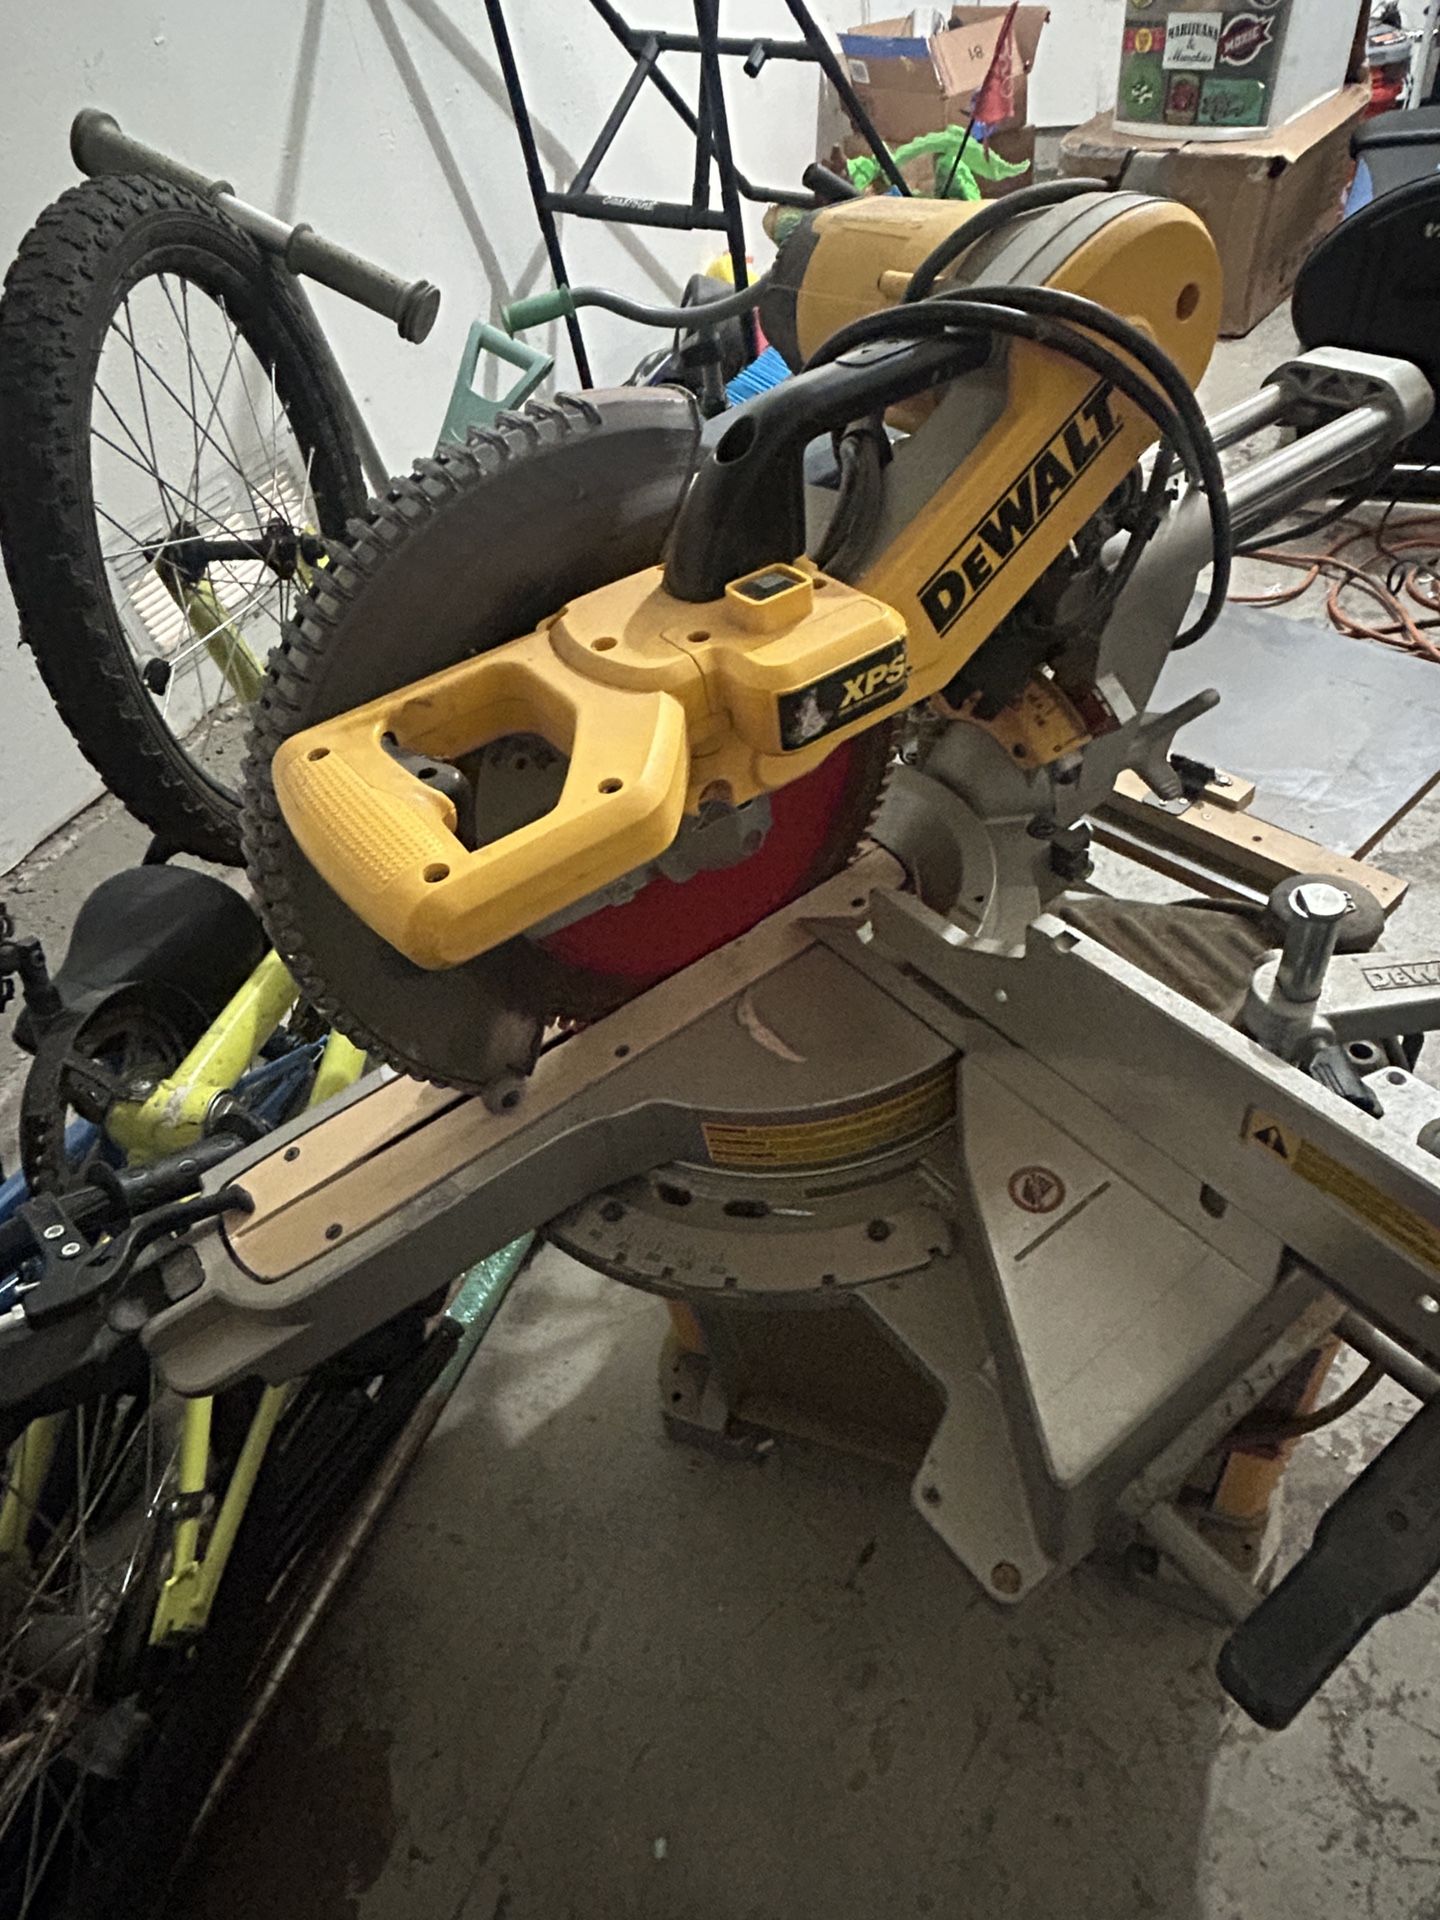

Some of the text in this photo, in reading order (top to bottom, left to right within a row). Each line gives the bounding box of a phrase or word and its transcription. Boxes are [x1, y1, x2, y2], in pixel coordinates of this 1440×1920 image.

[919, 382, 1117, 634] DEWALT
[839, 653, 907, 709] XPS
[1362, 964, 1440, 989] DEW
